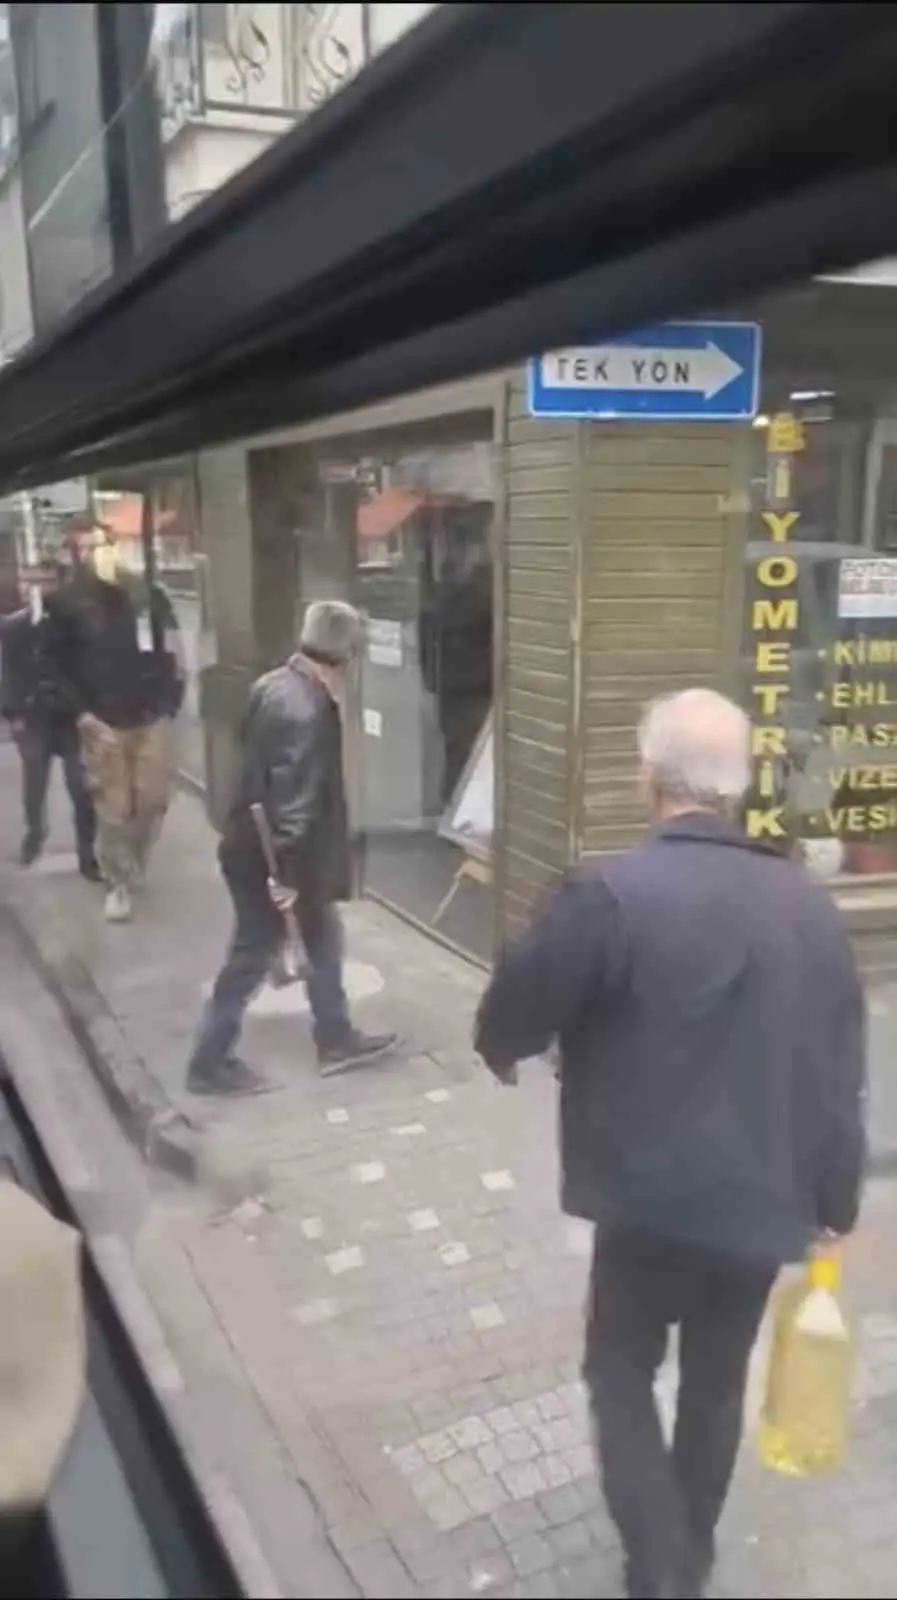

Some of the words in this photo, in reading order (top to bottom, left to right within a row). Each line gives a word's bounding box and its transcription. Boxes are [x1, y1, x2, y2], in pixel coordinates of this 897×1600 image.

[557, 358, 608, 381] TEK
[632, 357, 690, 383] YÖN
[746, 413, 805, 837] BİYOMETRİK
